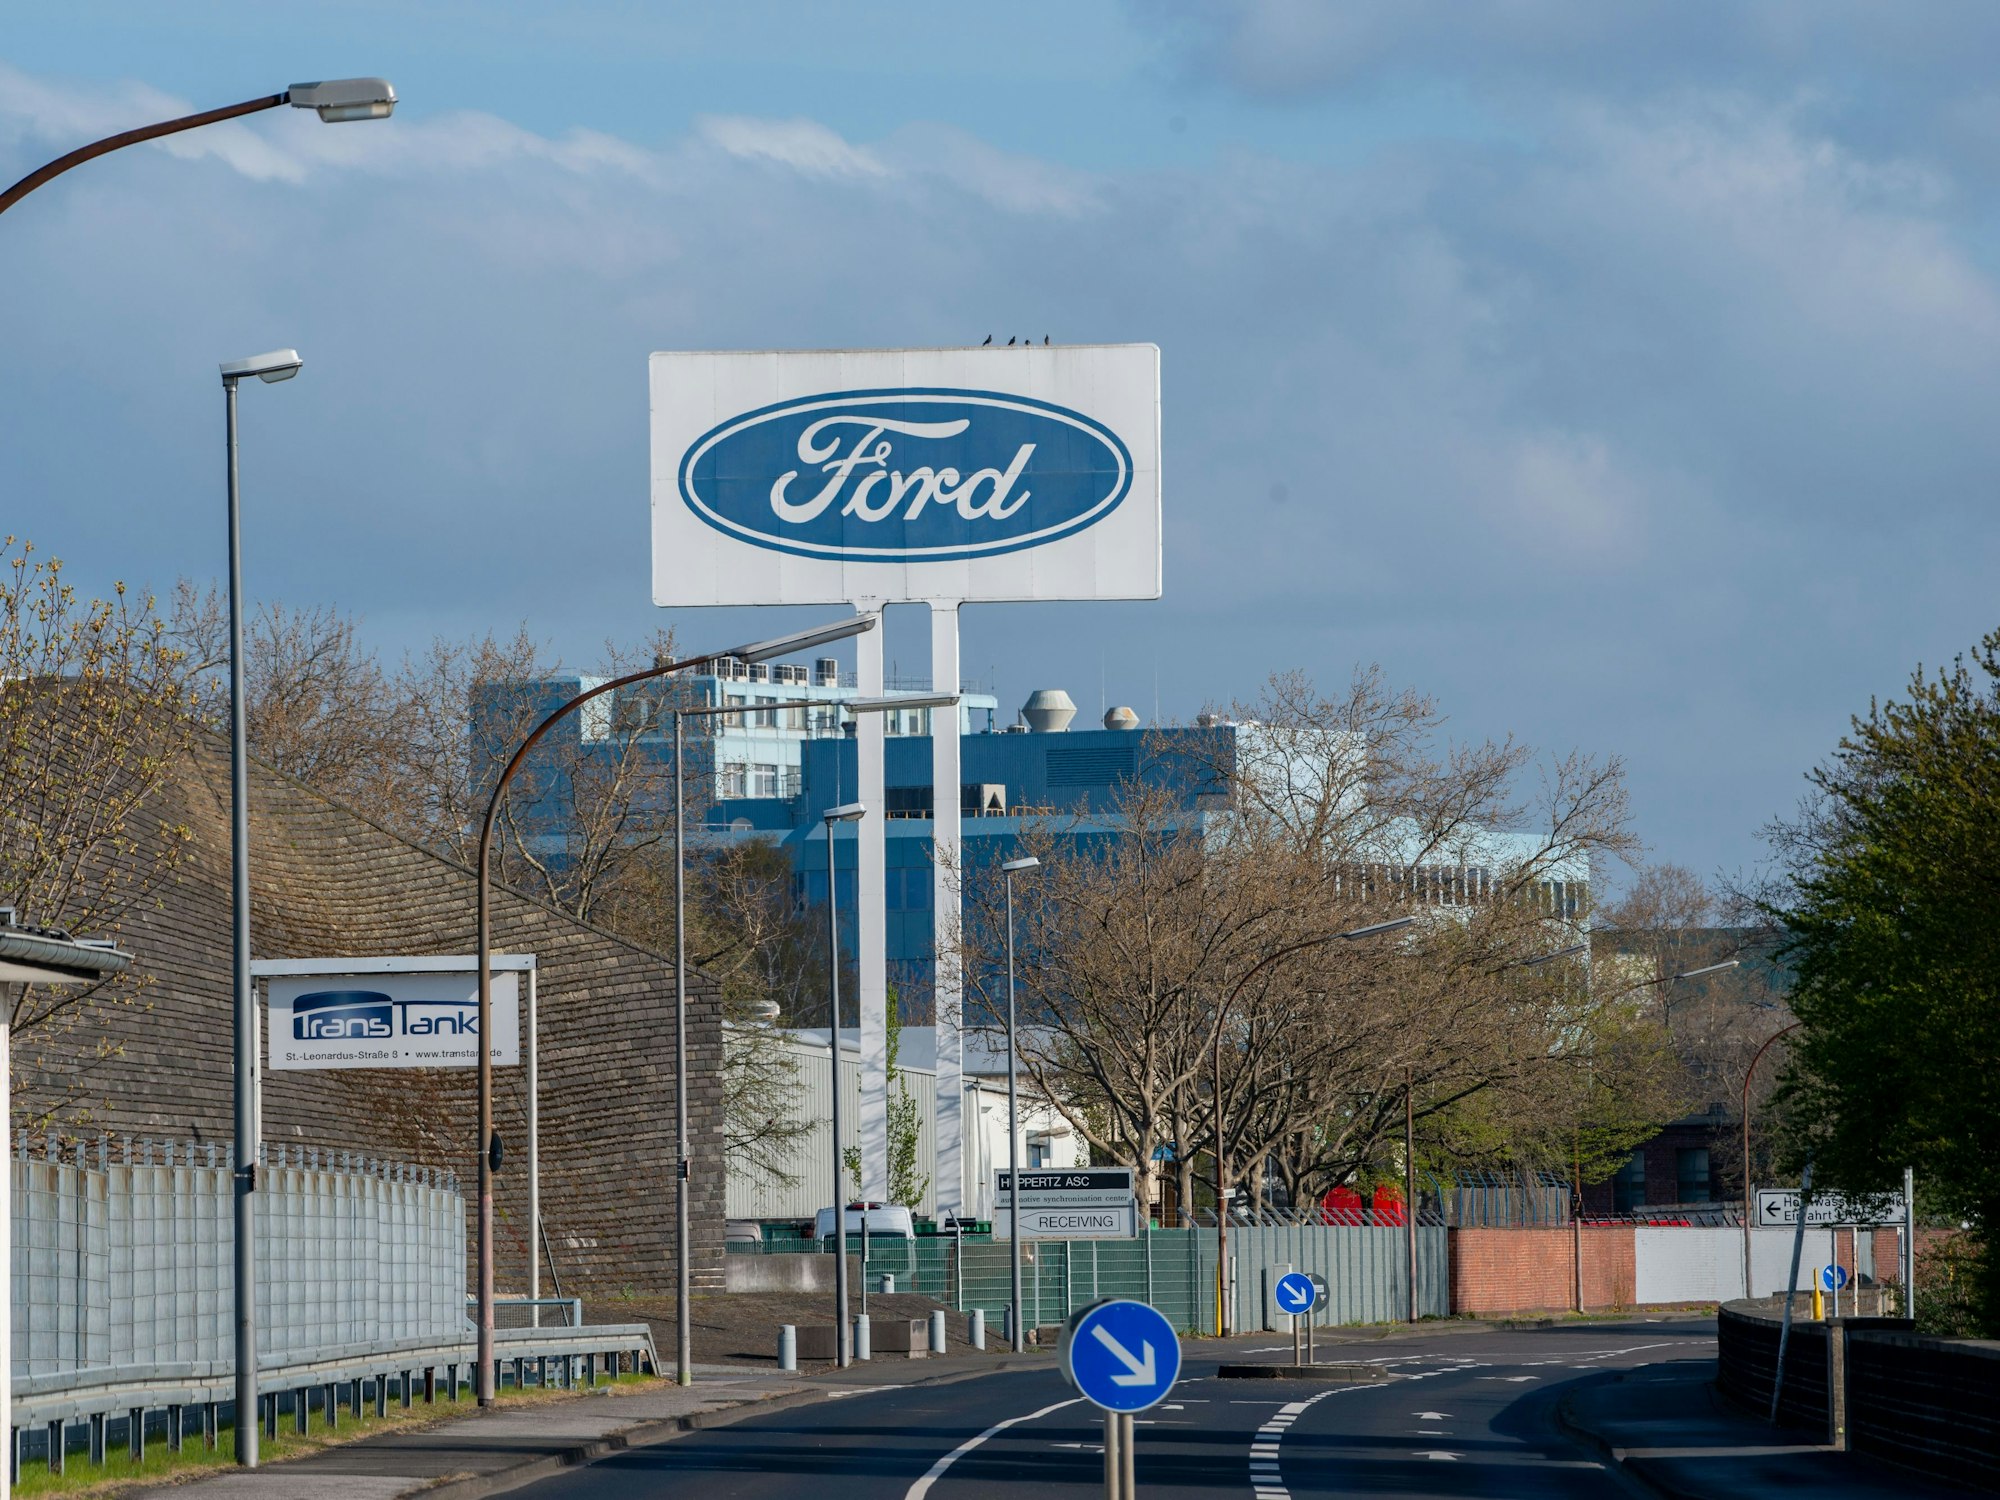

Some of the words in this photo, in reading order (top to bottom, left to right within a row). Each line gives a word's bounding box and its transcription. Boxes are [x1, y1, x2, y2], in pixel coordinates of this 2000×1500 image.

[770, 415, 1037, 523] Ford
[285, 1050, 389, 1061] St.-Leonardus-Straße
[1001, 1176, 1062, 1188] HPPERTZ
[1065, 1176, 1090, 1187] ASC
[1043, 1194, 1102, 1204] synchronisation
[1039, 1215, 1114, 1228] RECEIVING
